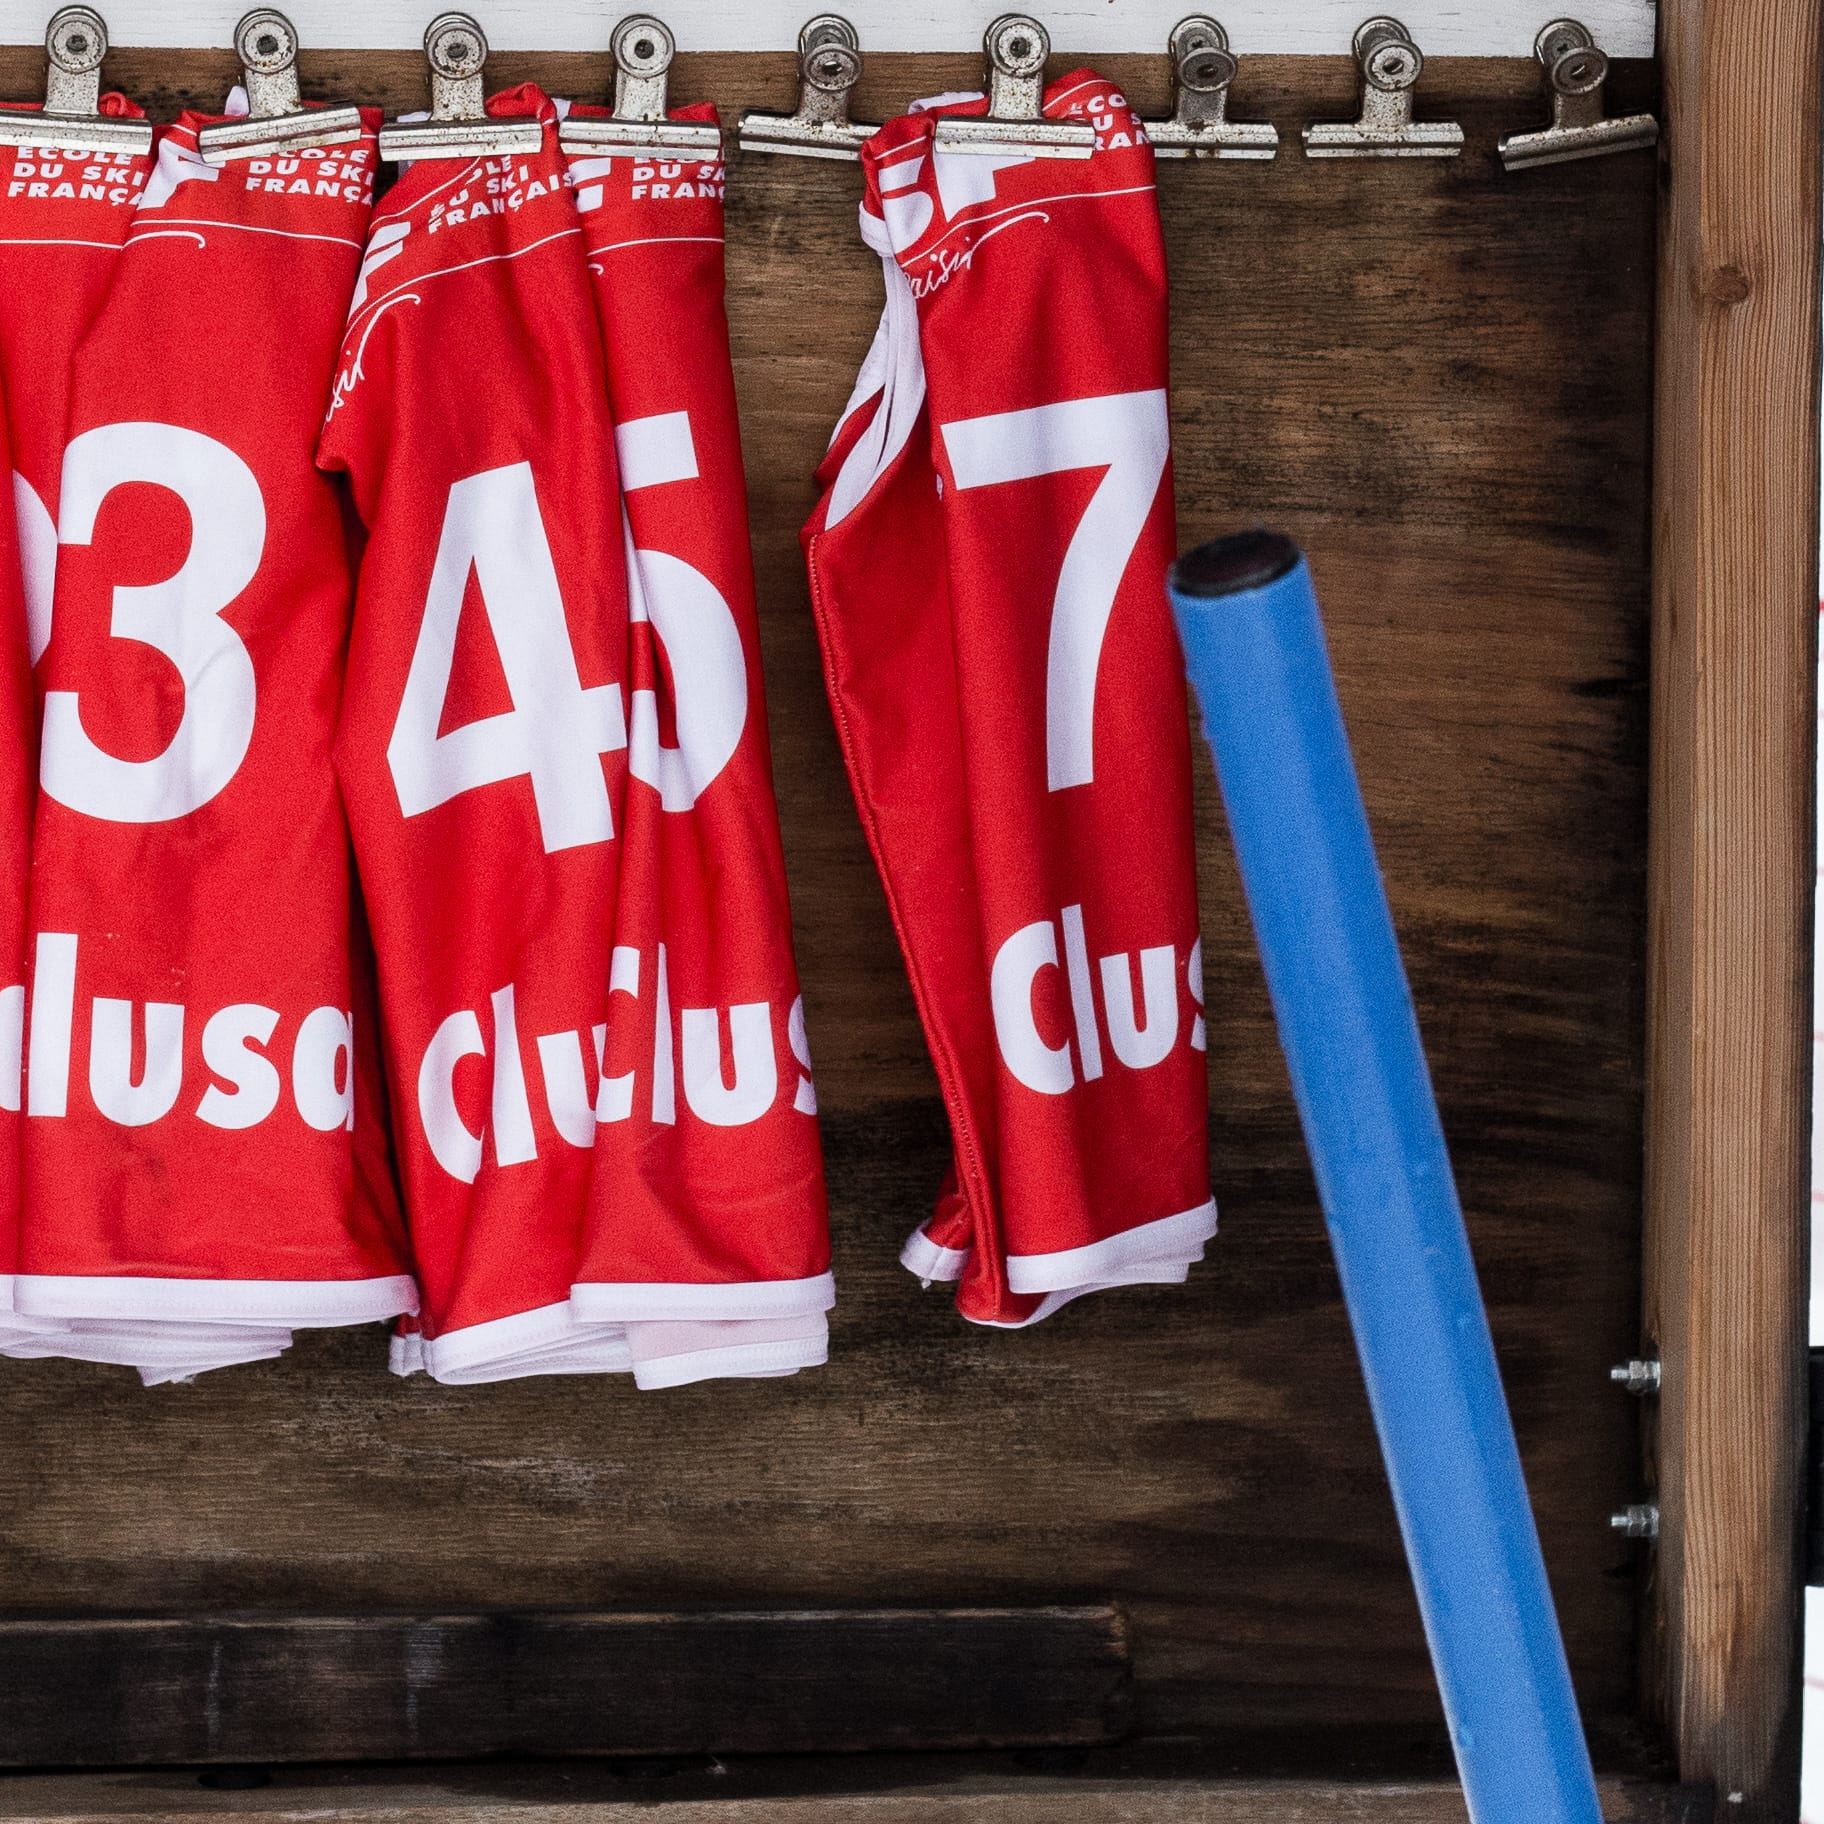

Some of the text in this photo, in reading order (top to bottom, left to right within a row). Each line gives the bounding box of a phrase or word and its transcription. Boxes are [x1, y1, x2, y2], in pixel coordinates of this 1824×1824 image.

[13, 162, 146, 187] DU SKI
[248, 160, 374, 185] DU SKI
[486, 164, 531, 196] SKI
[632, 165, 681, 183] DU
[939, 388, 1171, 794] 7
[39, 421, 268, 824] 3
[387, 460, 628, 855] 4
